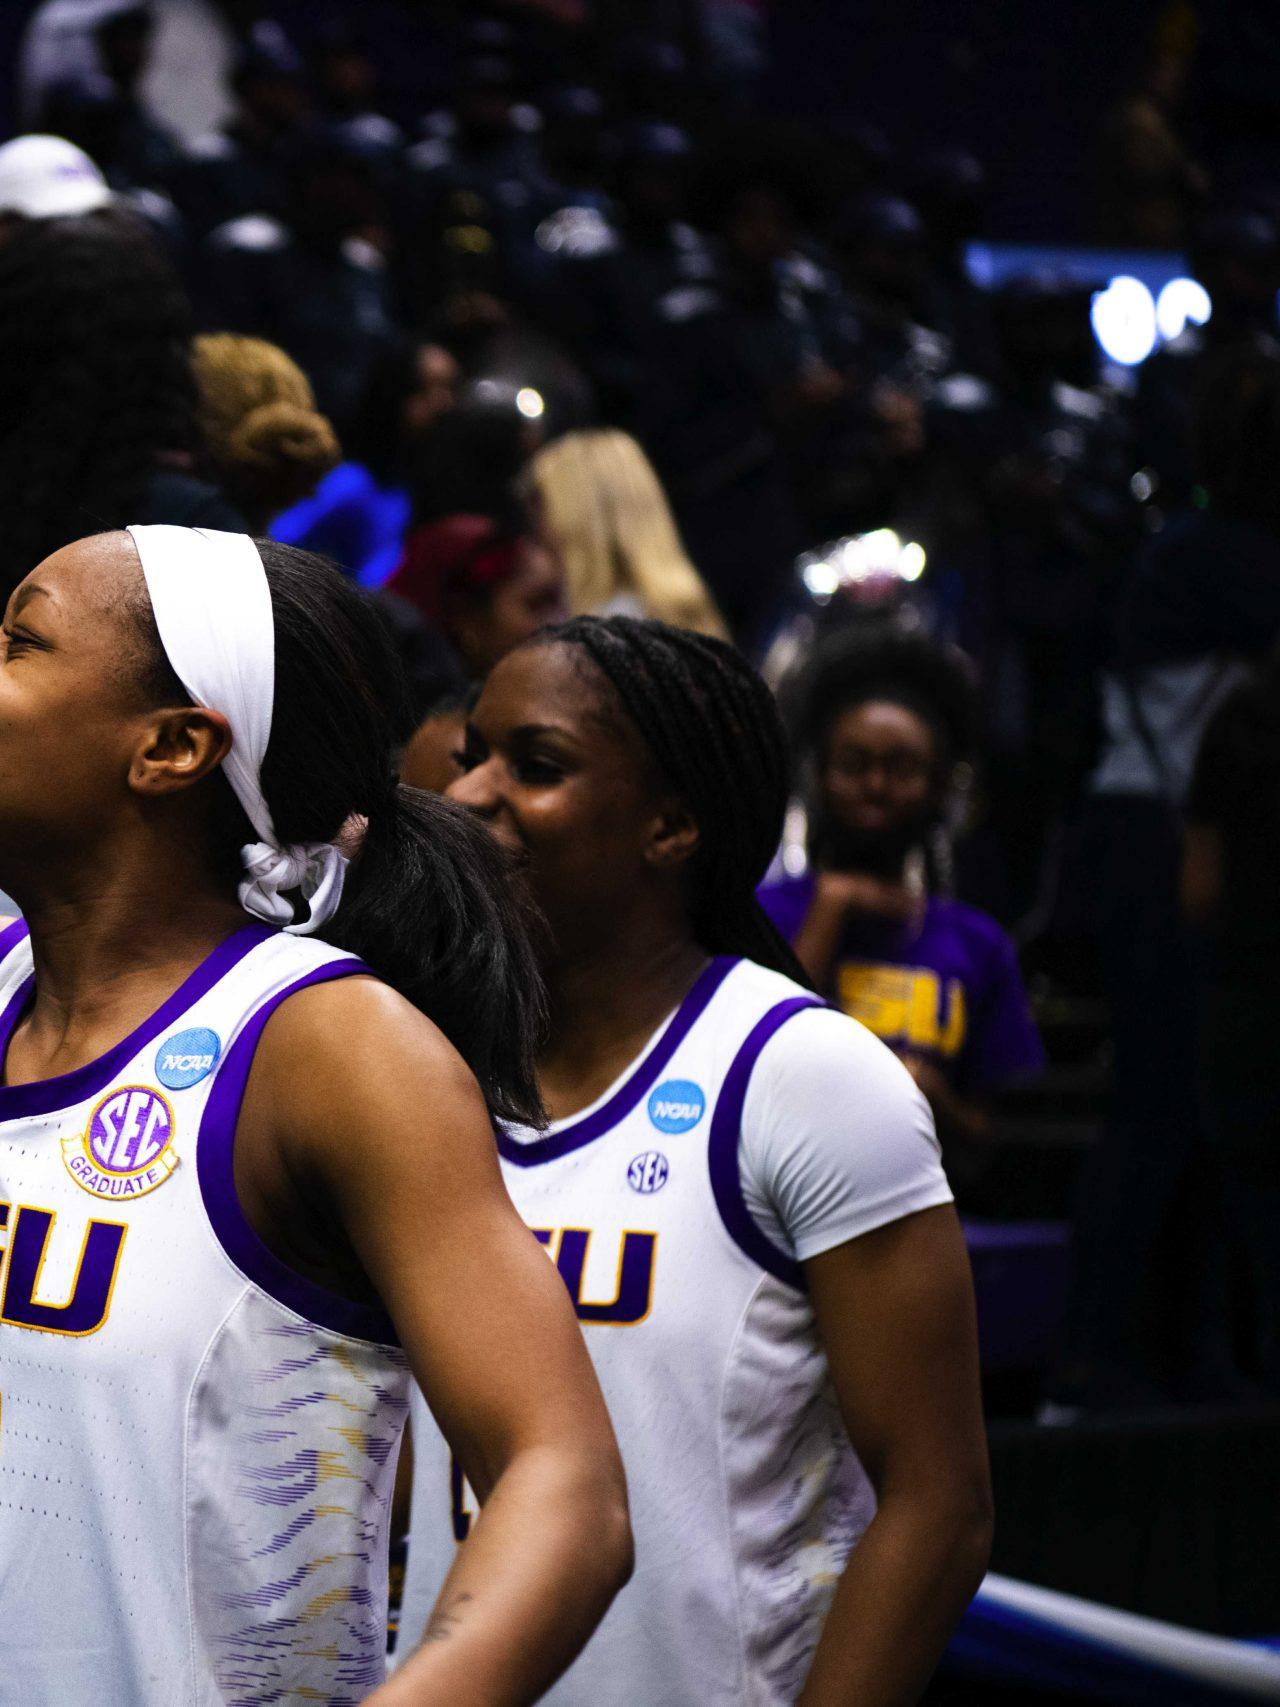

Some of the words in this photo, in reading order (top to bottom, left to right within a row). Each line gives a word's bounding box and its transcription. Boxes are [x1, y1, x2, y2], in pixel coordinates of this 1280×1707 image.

[161, 1054, 215, 1071] NCAA
[92, 1091, 169, 1168] SEC
[654, 1101, 702, 1120] NCAA
[70, 1155, 160, 1195] GRADUATE
[628, 1151, 668, 1194] SEC
